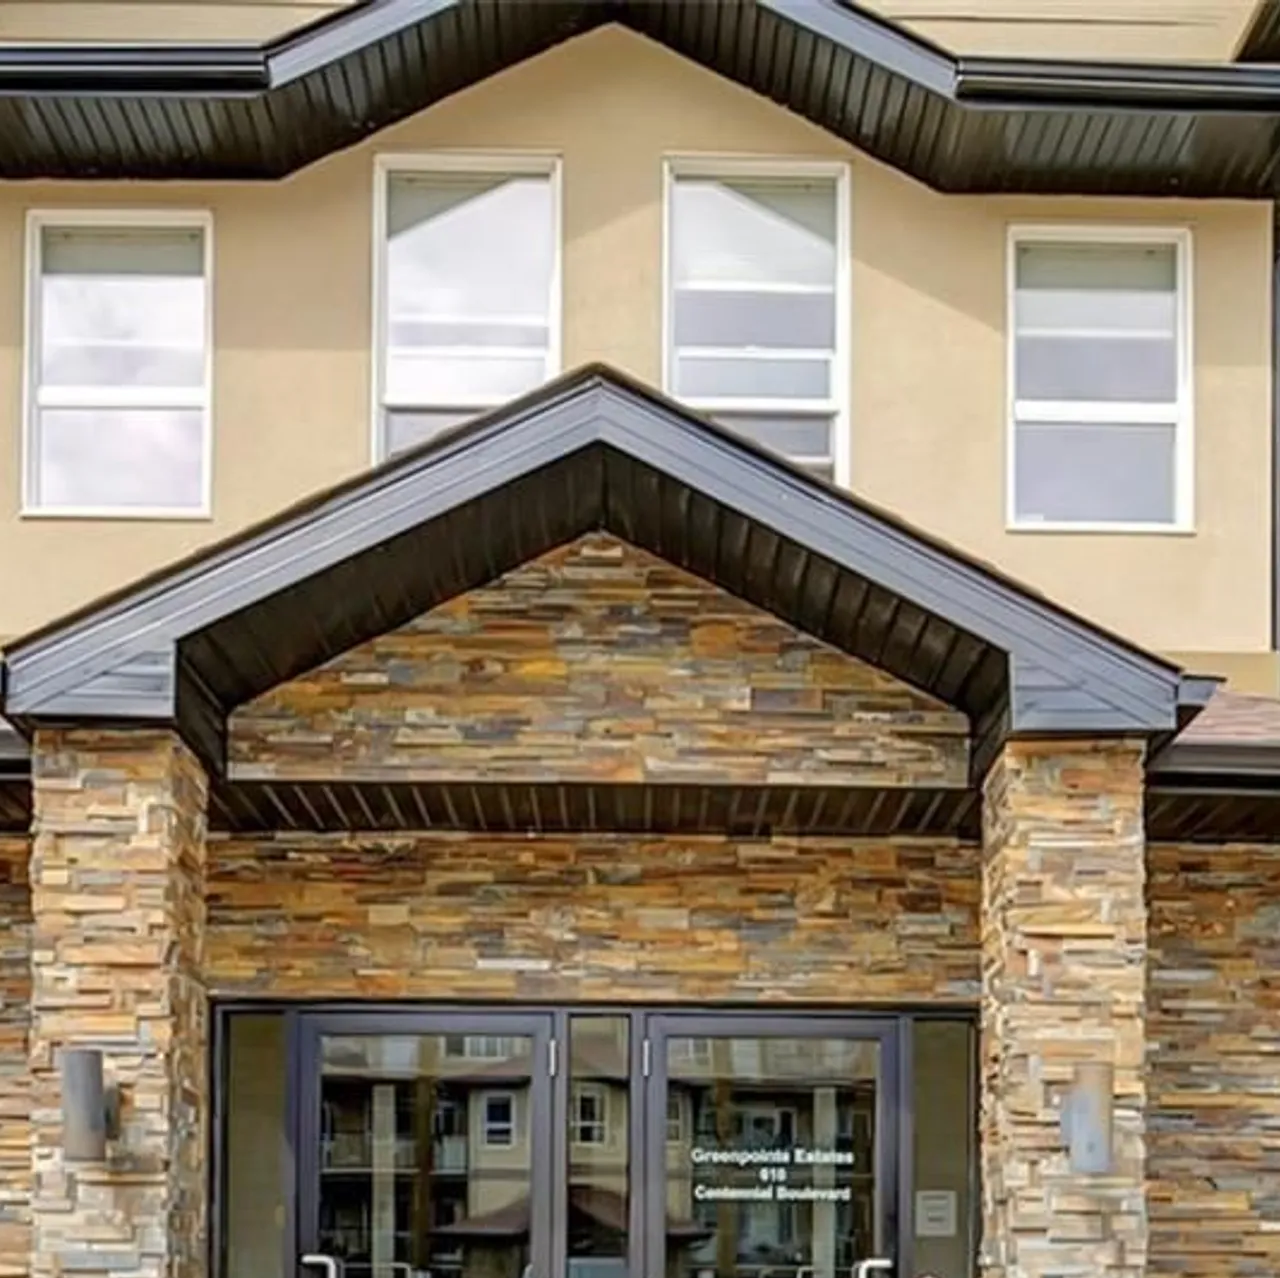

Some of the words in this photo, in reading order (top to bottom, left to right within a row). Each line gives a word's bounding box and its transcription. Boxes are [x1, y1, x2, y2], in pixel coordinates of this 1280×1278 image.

[793, 1148, 855, 1165] Estates
[695, 1184, 773, 1200] Centennial
[776, 1185, 852, 1201] Boulevard
